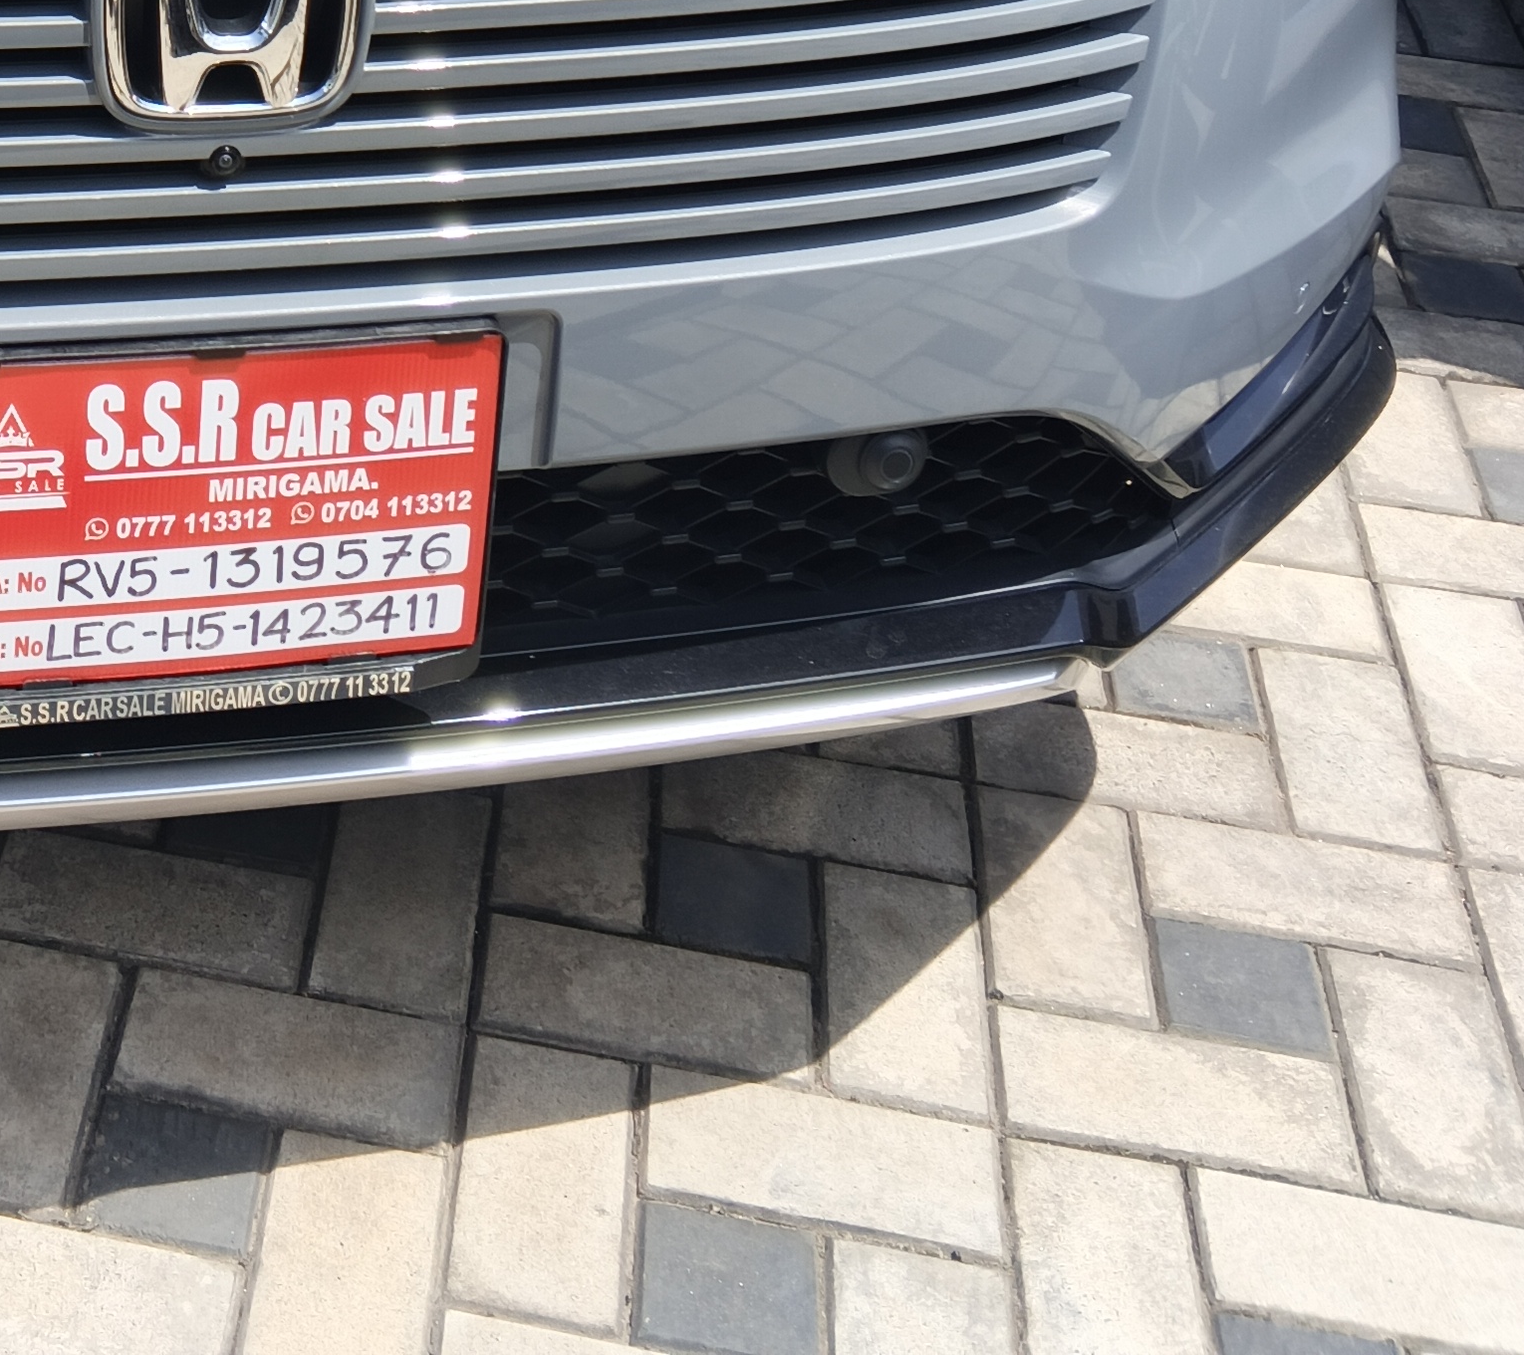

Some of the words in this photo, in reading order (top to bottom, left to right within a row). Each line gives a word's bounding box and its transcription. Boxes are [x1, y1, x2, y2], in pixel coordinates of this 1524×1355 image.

[85, 379, 240, 470] S.S.R
[251, 399, 351, 461] CAR
[363, 388, 478, 453] SALE
[15, 478, 65, 493] SALE
[208, 468, 379, 503] MIRIGAMA.
[116, 515, 176, 539] 0777
[184, 508, 272, 534] 113312
[321, 499, 378, 523] 0704
[387, 490, 472, 518] 113312
[17, 571, 47, 593] No
[57, 531, 452, 602] RV5-1319576
[14, 635, 44, 658] No
[20, 701, 70, 725] S.S.R
[73, 697, 112, 721] CAR
[116, 692, 166, 717] SALE
[171, 684, 266, 715] MIRIGAMA
[297, 677, 341, 703] 0777
